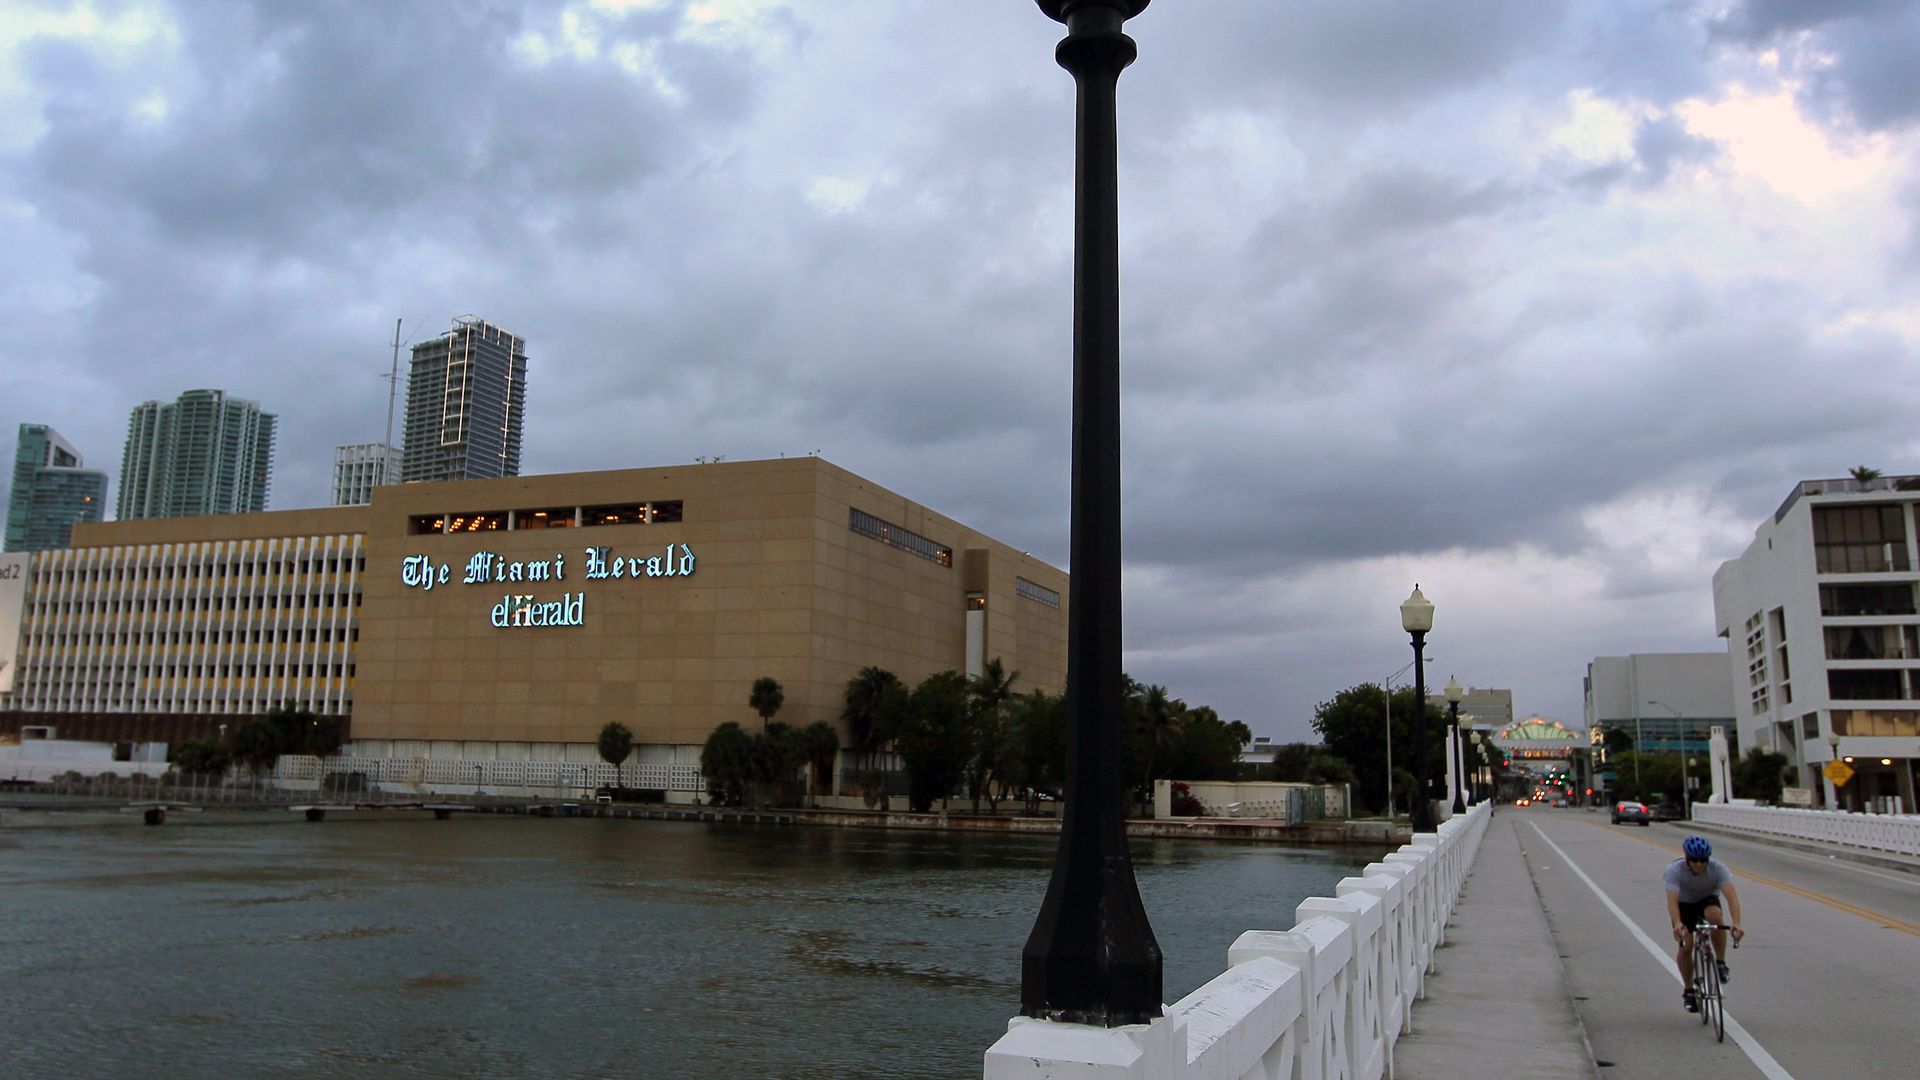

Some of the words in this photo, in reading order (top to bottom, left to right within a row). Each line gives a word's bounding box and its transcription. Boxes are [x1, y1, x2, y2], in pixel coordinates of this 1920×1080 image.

[402, 554, 450, 591] The
[463, 550, 564, 584] Miami
[585, 543, 695, 580] Herald
[491, 594, 509, 627] el
